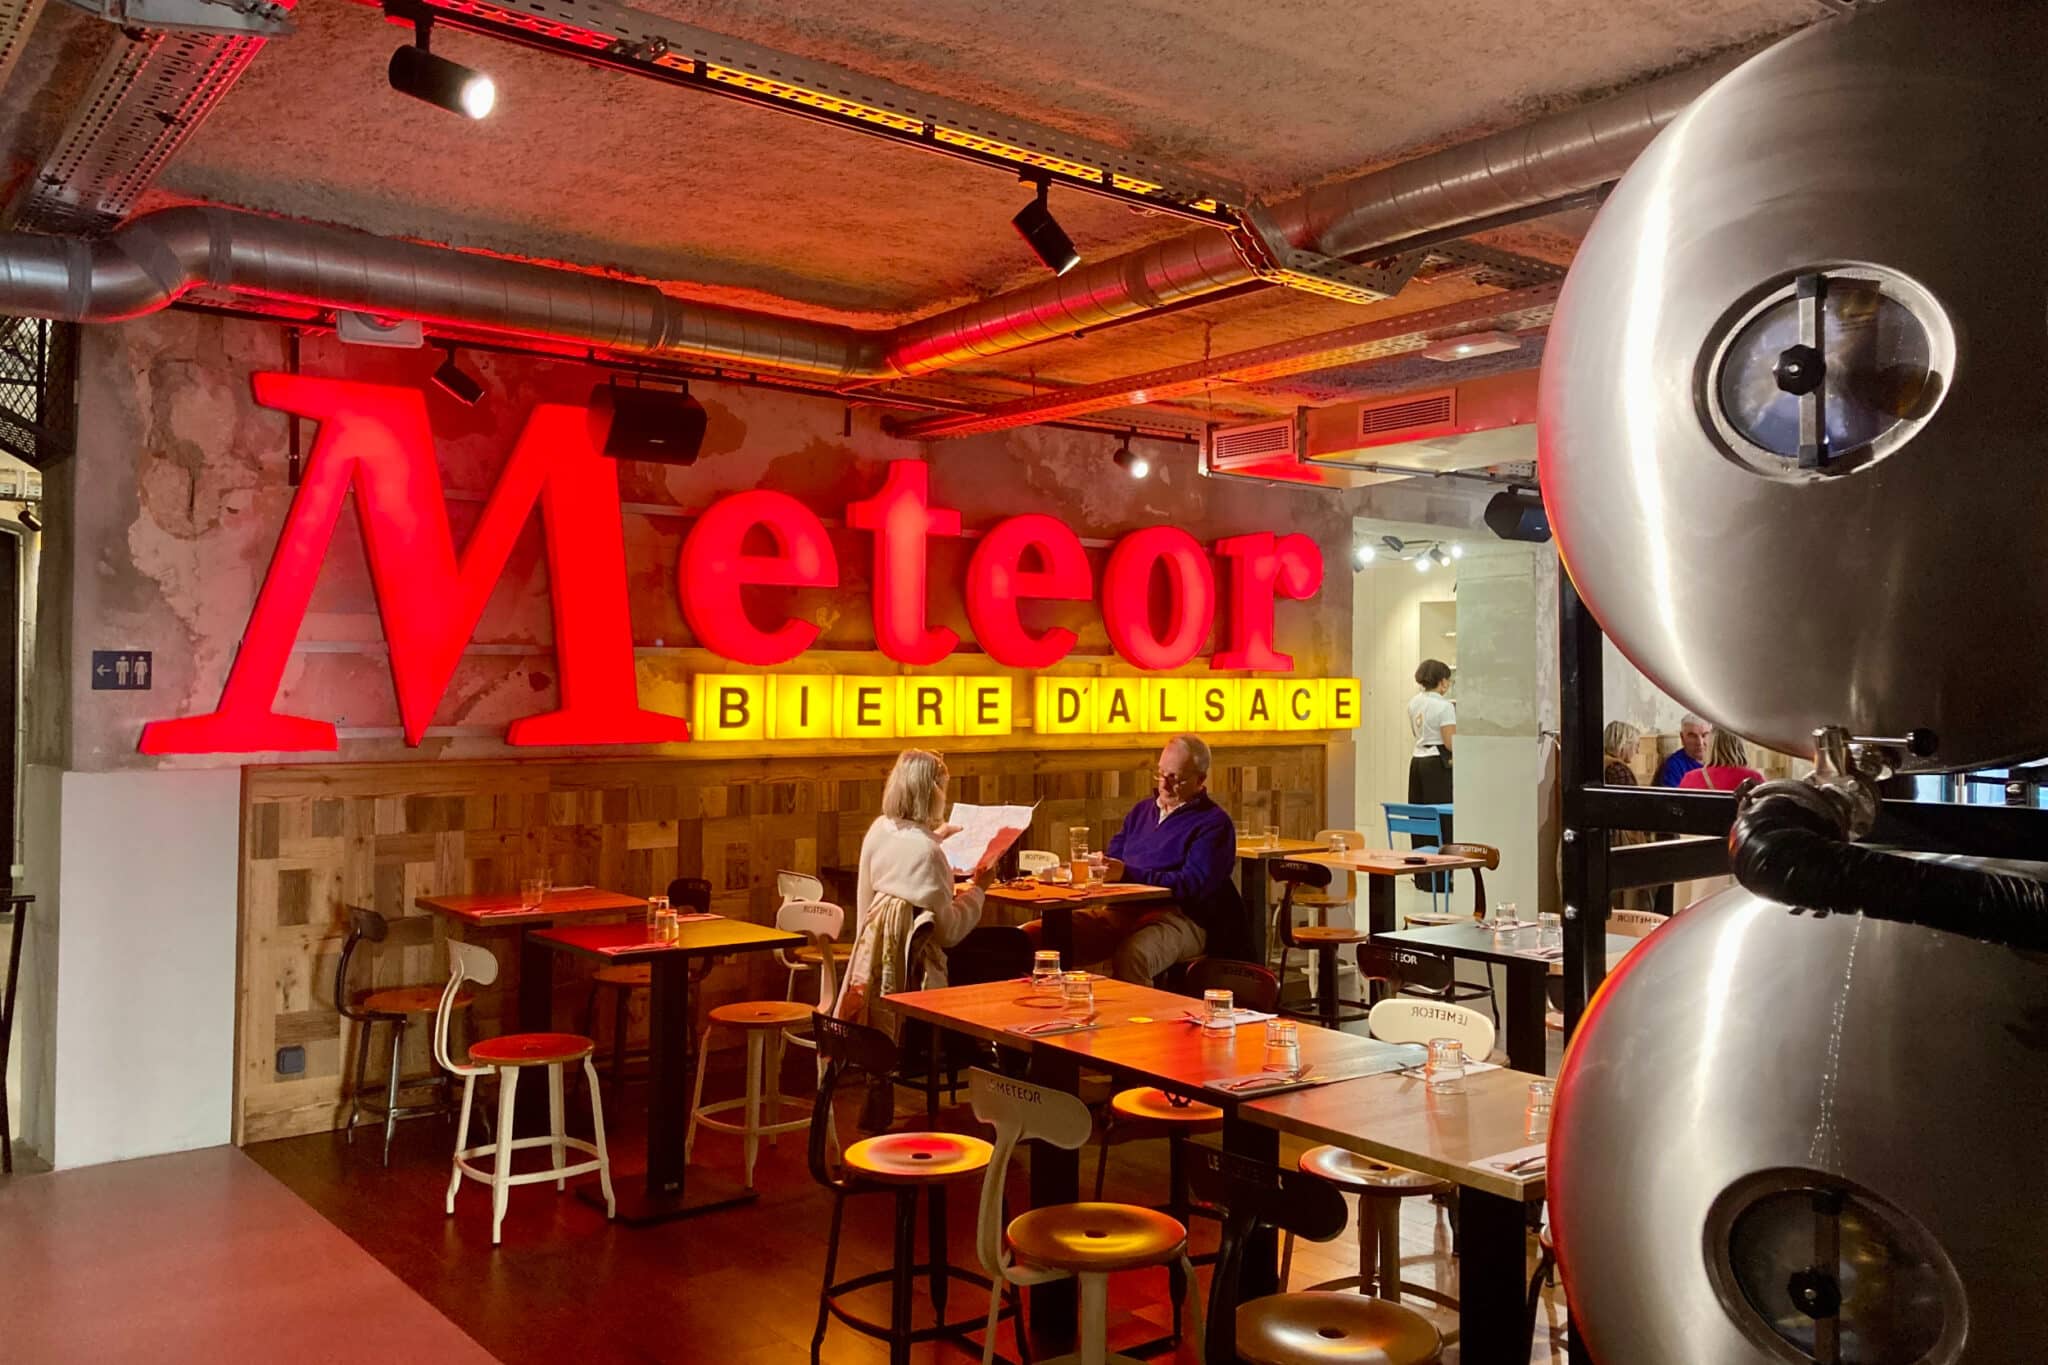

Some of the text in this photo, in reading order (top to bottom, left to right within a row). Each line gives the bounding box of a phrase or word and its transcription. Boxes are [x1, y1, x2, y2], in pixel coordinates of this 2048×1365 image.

[138, 371, 1323, 754] Meteor
[719, 686, 1352, 728] BIERE D'ALSACE
[995, 1080, 1042, 1105] METEOR
